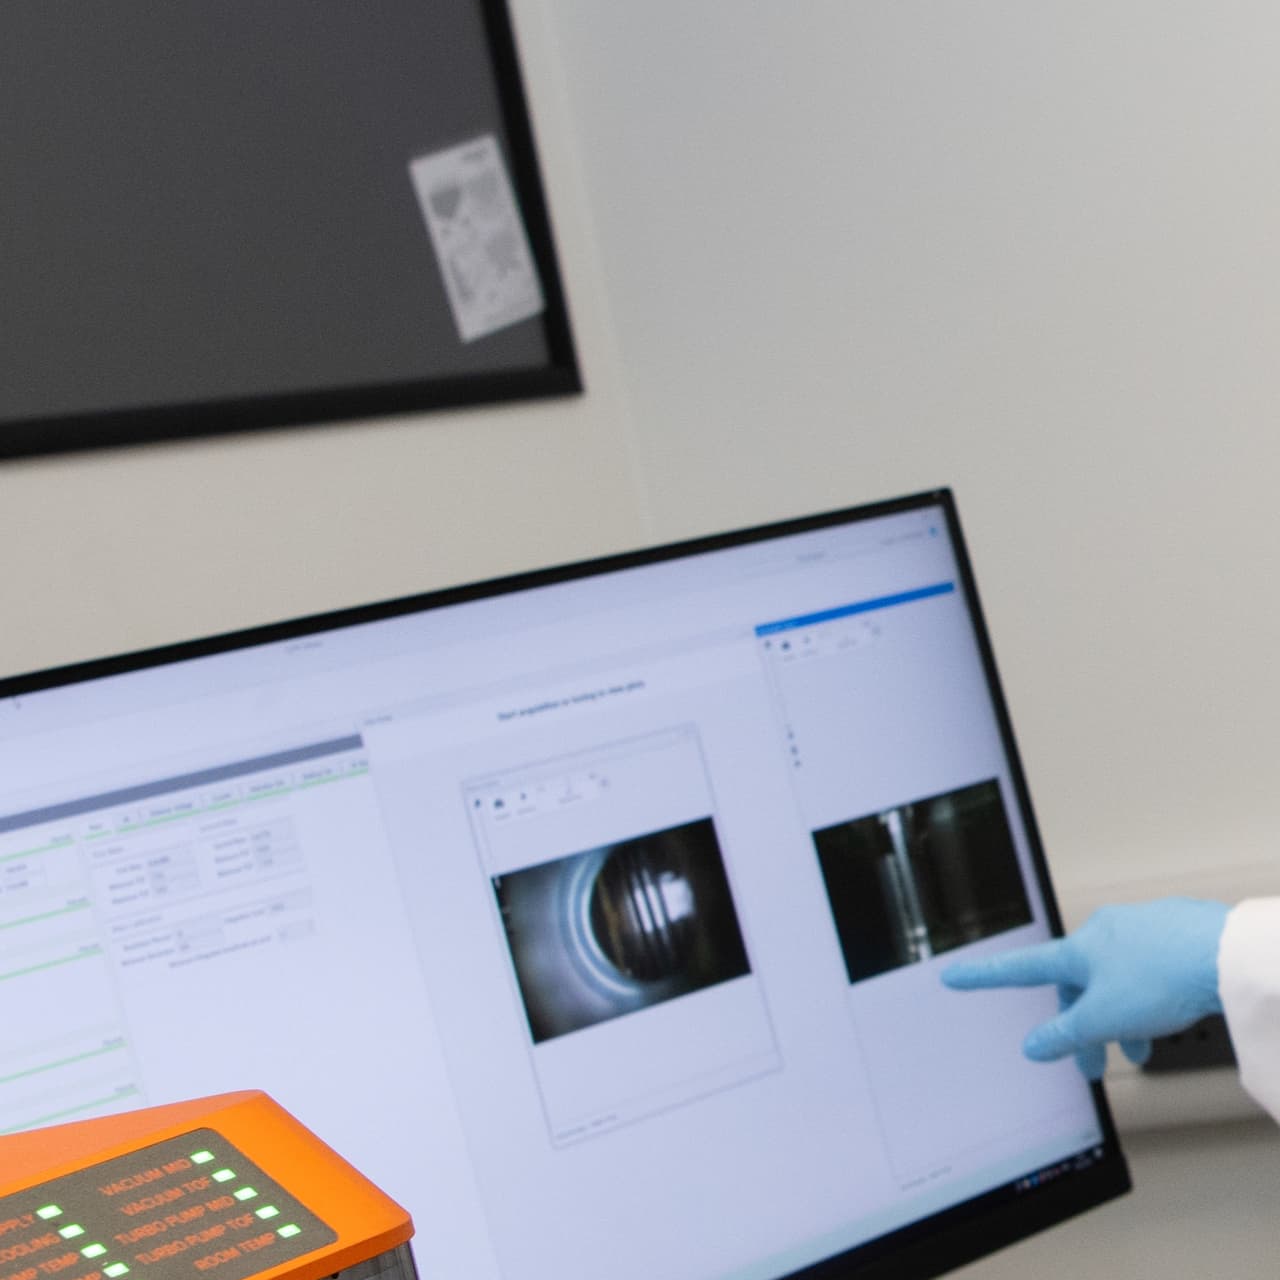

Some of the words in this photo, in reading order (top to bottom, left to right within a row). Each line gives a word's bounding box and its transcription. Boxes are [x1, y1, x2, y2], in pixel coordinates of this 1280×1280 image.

[99, 1168, 164, 1196] VACUUM
[119, 1187, 185, 1216] VACUUM
[0, 1214, 34, 1236] PPLY
[114, 1220, 168, 1244] TURBO
[165, 1205, 206, 1226] PUMP
[135, 1240, 188, 1264] TURBO
[185, 1224, 226, 1245] PUMP
[193, 1247, 241, 1269] ROOM
[238, 1232, 275, 1252] TEMP
[38, 1252, 79, 1273] TEMP
